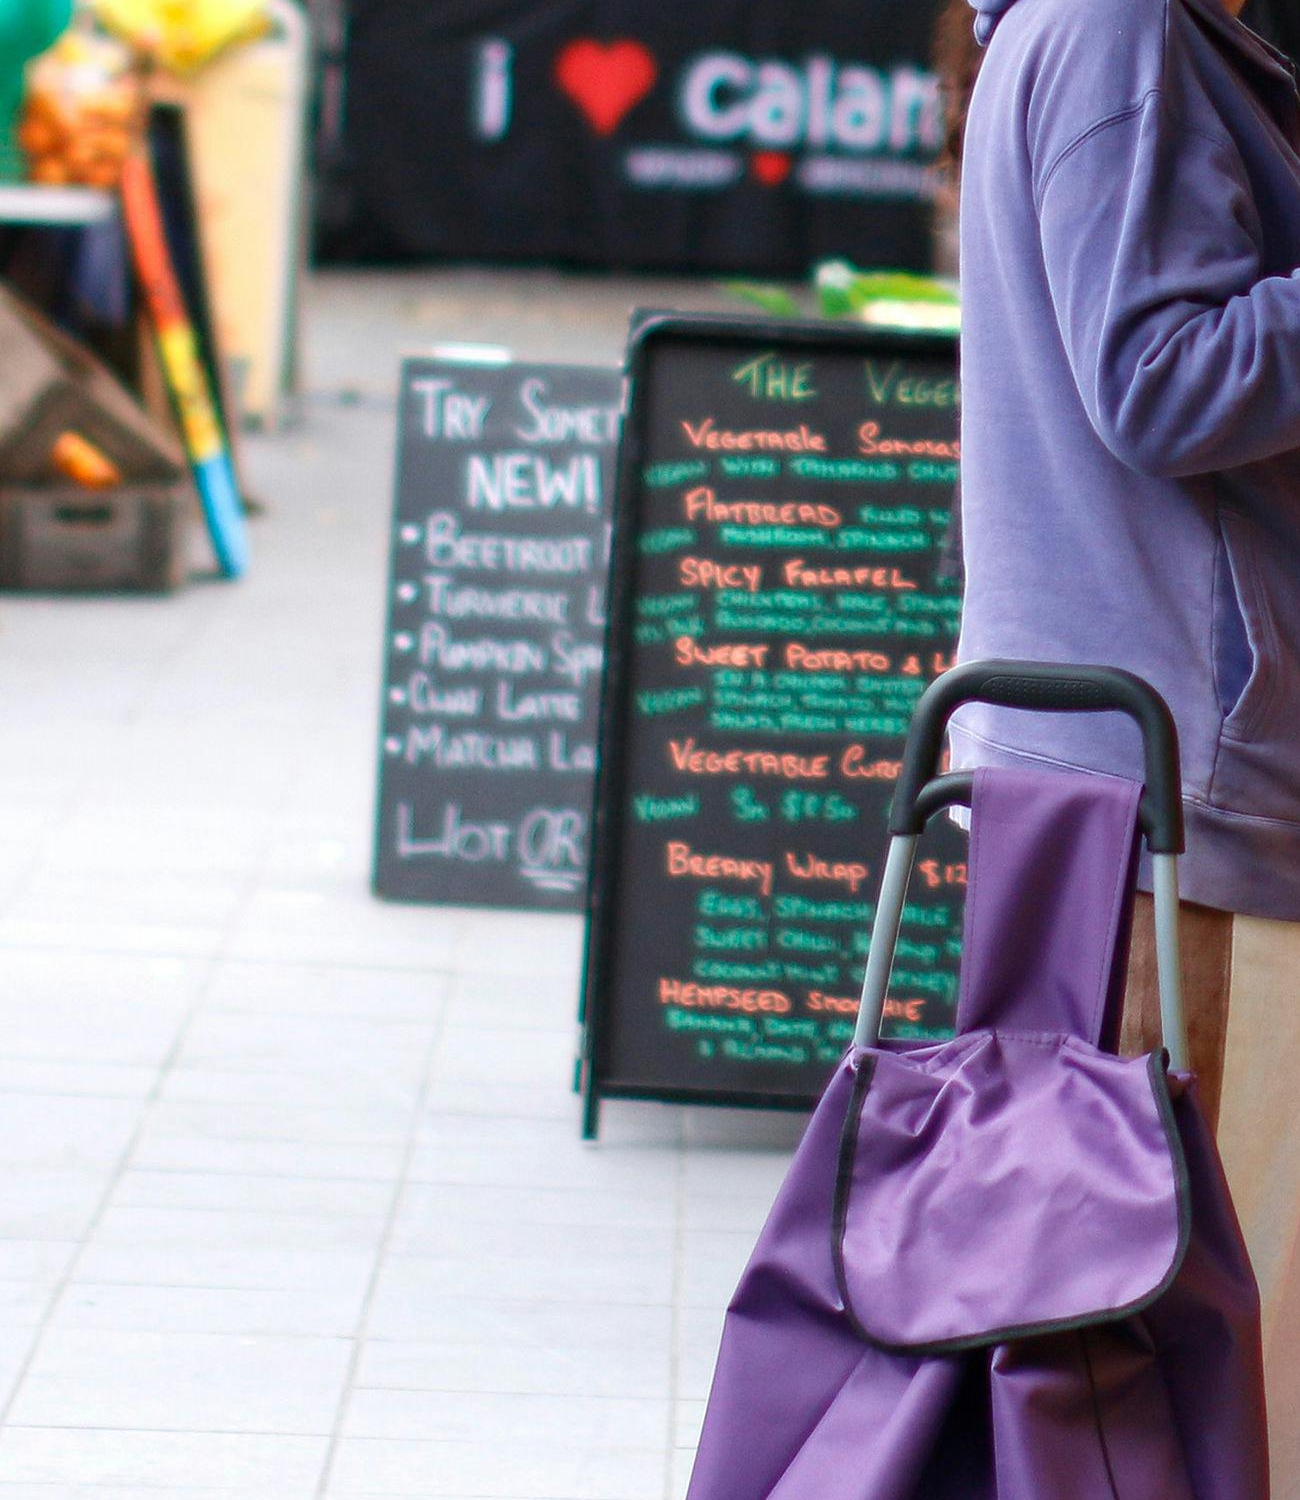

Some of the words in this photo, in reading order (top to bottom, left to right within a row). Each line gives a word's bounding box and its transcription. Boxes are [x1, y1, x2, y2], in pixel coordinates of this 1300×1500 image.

[732, 353, 816, 398] THE
[865, 357, 961, 405] VEGE
[411, 377, 493, 440] TRY
[467, 453, 599, 514] NEW!
[426, 512, 592, 571] BEETROOT
[680, 556, 762, 592] SPICY
[784, 558, 918, 591] FALAFEL
[675, 635, 769, 669] SWEET
[786, 642, 891, 673] POTATO
[669, 737, 831, 780] VEGETABLE
[519, 808, 584, 867] OR
[667, 841, 775, 897] BREAKY
[786, 852, 870, 894] WRAP
[659, 977, 791, 1013] HEMPSEED
